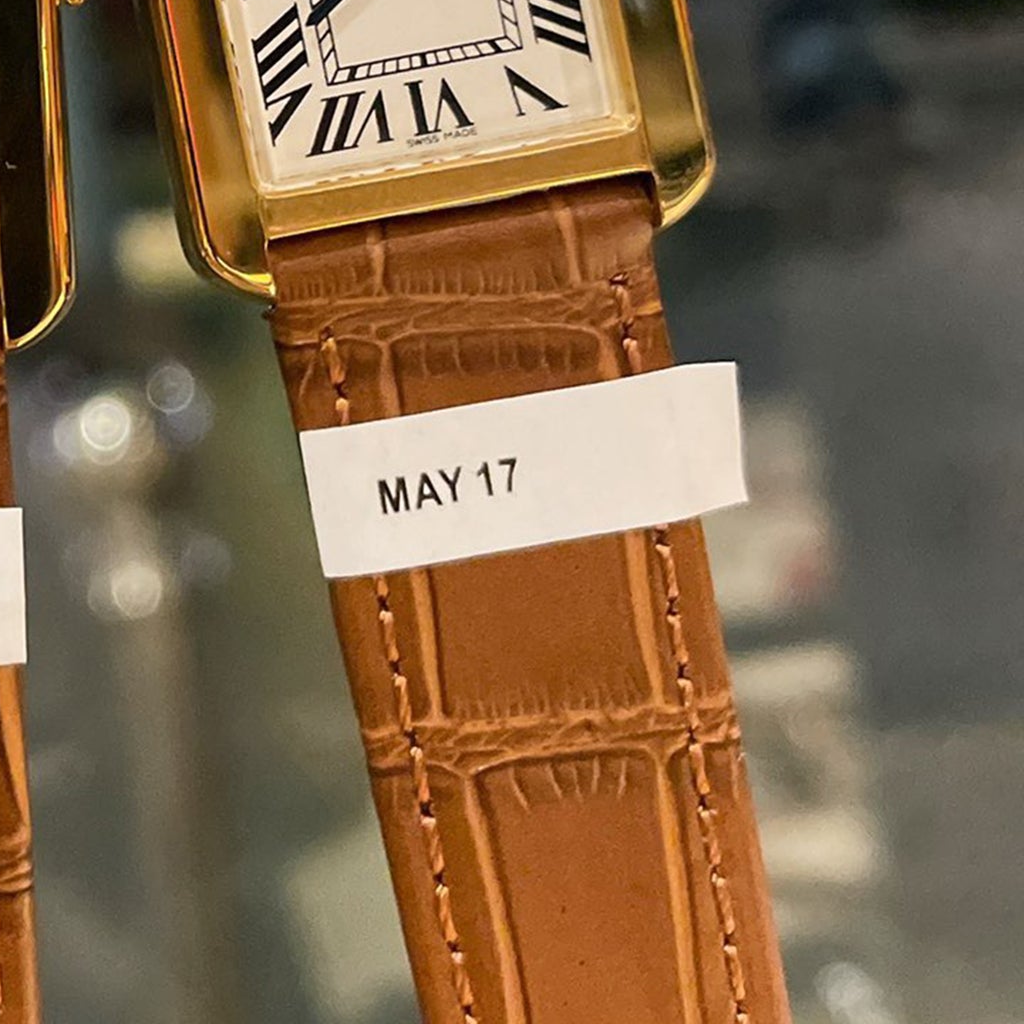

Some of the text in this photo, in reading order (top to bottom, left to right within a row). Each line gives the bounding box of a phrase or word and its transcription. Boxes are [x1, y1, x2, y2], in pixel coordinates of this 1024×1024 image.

[405, 127, 478, 148] SWISS MADE
[378, 457, 517, 515] MAY 17
